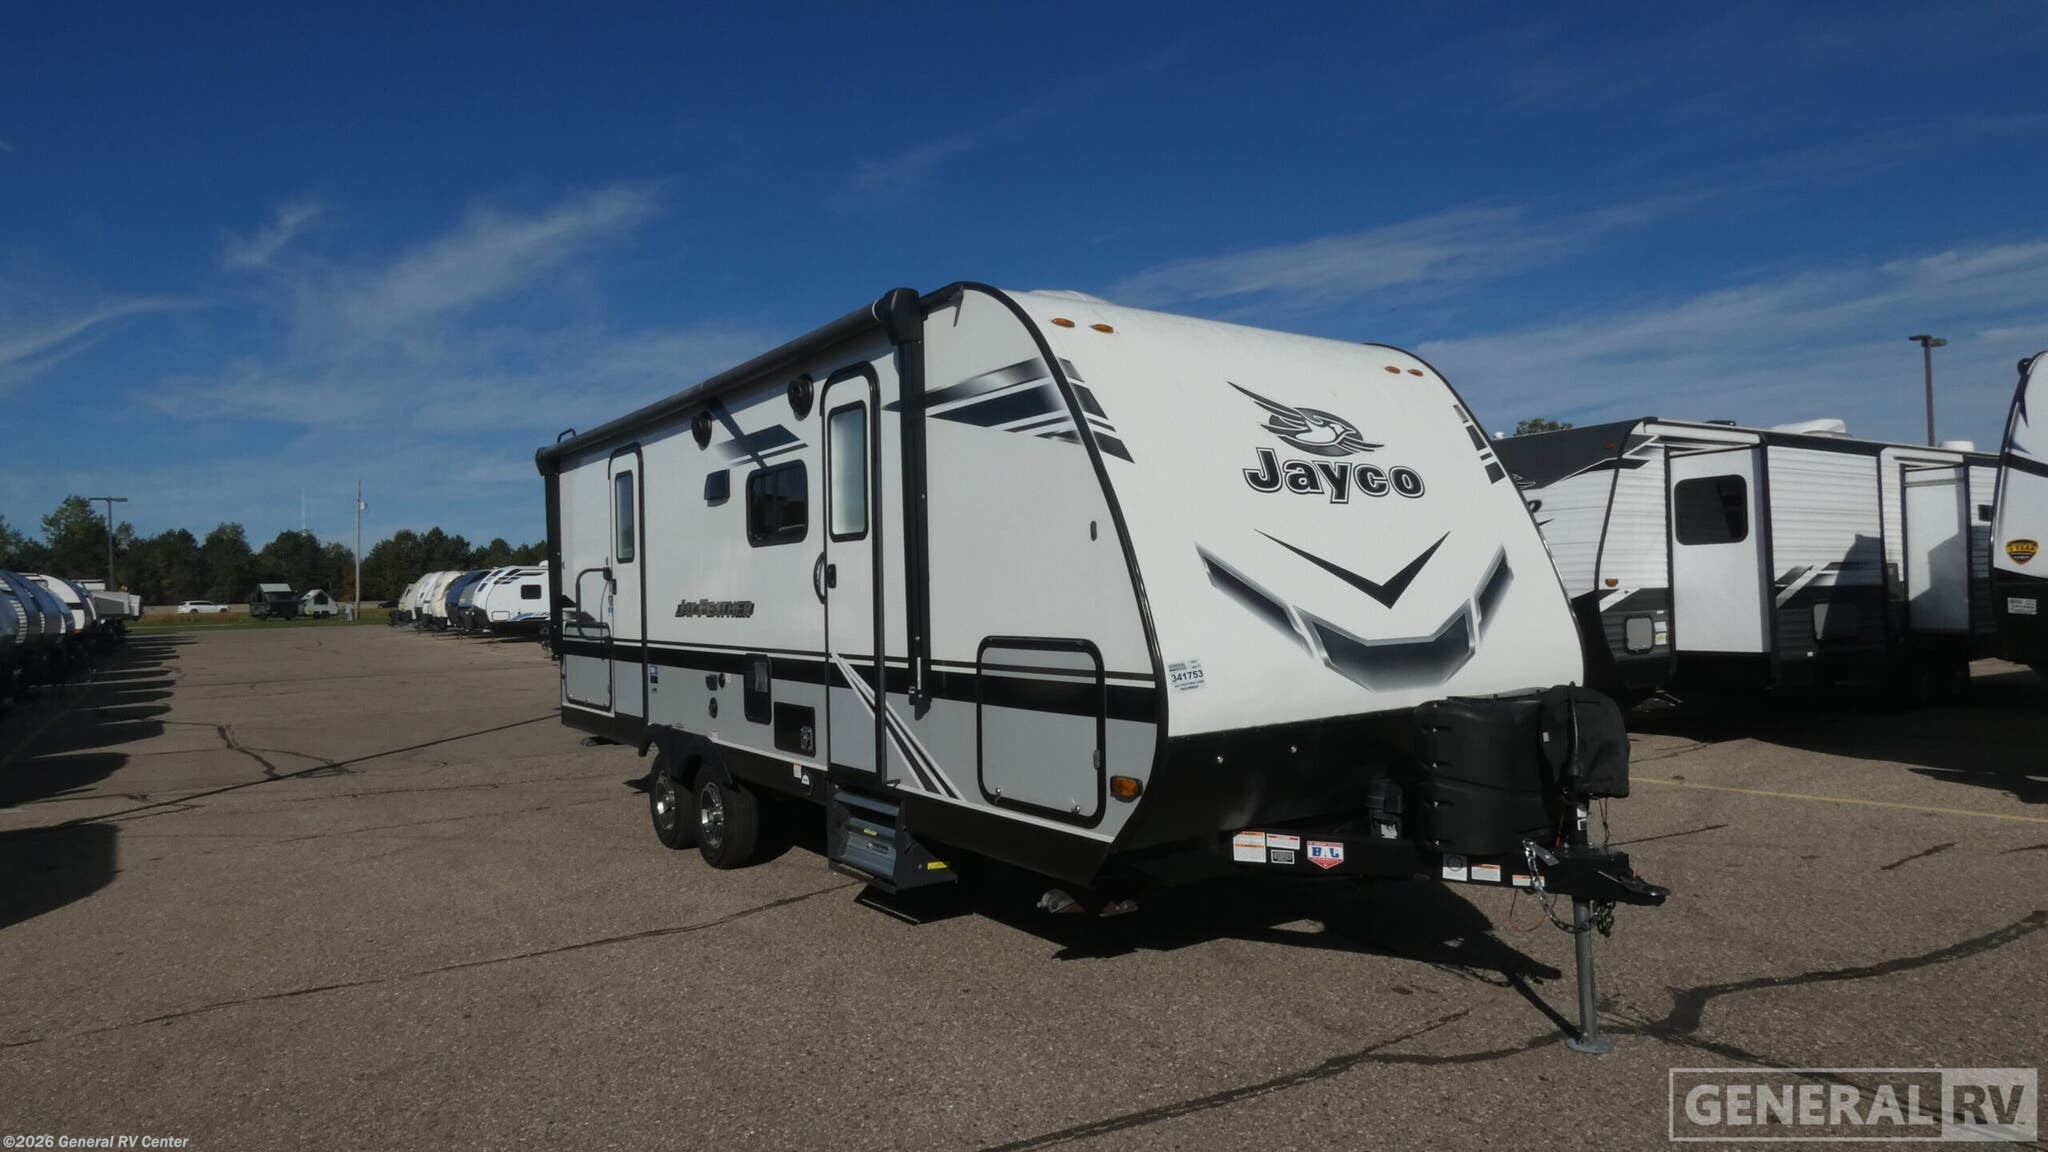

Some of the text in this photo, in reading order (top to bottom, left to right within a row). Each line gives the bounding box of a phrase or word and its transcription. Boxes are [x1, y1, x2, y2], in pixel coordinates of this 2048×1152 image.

[1243, 447, 1426, 505] Jayco
[1171, 669, 1204, 683] 341753
[1311, 846, 1340, 859] BL
